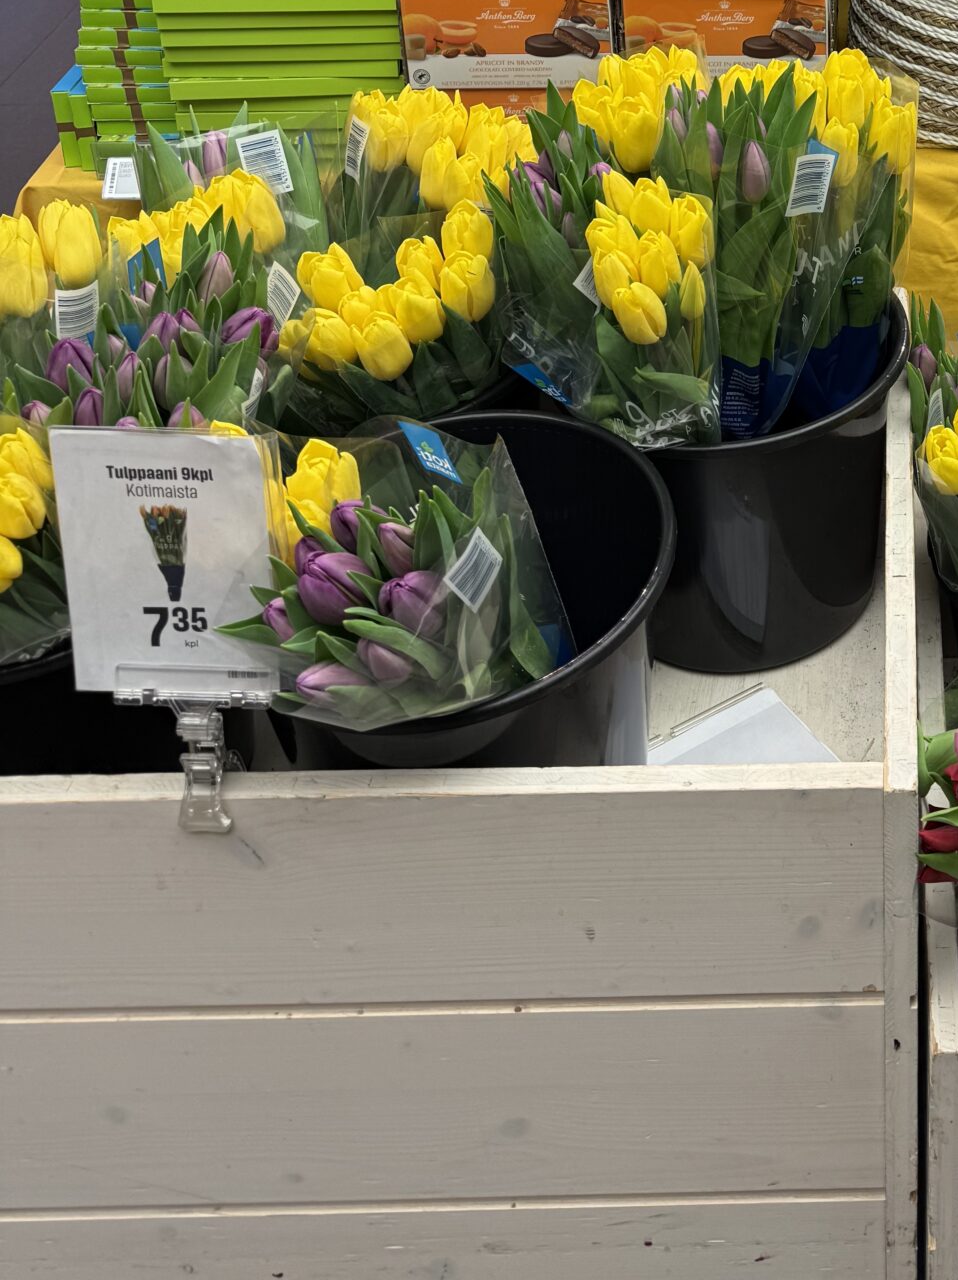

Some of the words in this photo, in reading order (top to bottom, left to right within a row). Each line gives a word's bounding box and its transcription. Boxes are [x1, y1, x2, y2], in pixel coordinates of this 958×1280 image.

[476, 10, 512, 20] Anthon
[512, 10, 536, 23] Berg
[696, 12, 732, 22] Anthon
[733, 12, 754, 25] Berg
[106, 465, 178, 481] Tulppaani
[182, 467, 214, 482] 9kpl
[126, 484, 198, 499] Kotimaista
[184, 640, 199, 648] kpl
